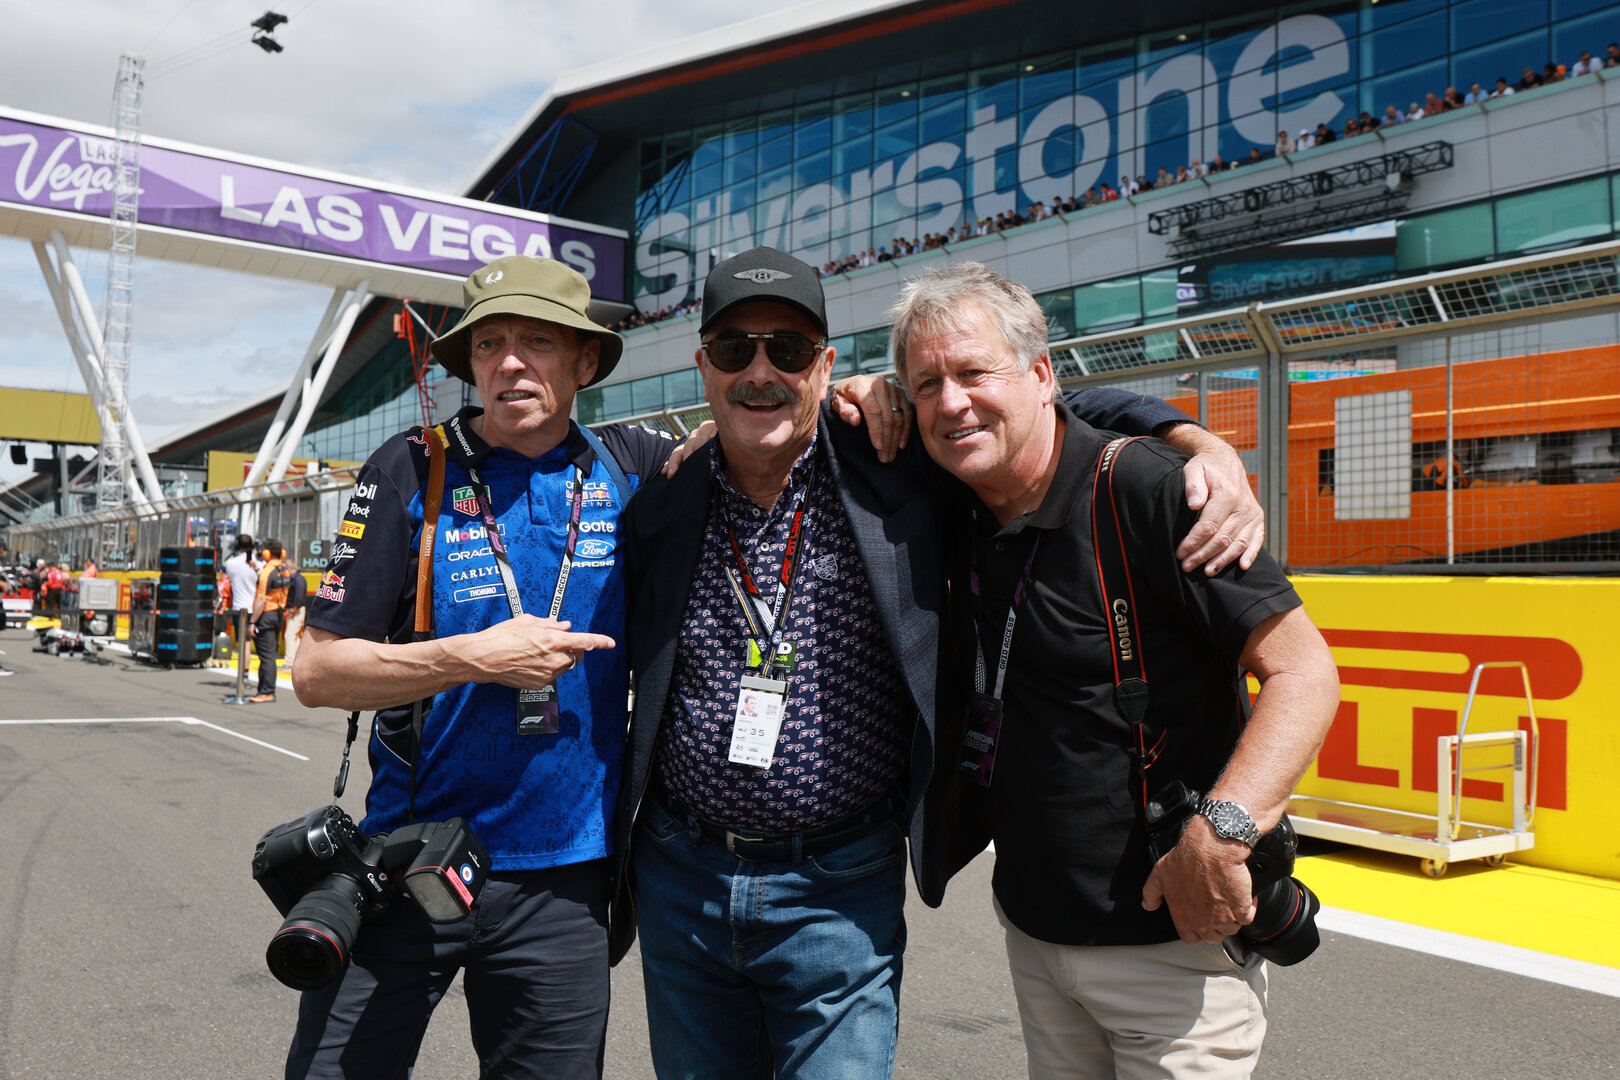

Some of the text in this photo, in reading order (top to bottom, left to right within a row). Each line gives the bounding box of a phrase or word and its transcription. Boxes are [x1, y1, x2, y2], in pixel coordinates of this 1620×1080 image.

[634, 14, 1350, 314] Silverstone
[220, 175, 597, 282] LAS VEGAS
[456, 487, 477, 499] TA
[349, 502, 370, 518] Rock
[456, 498, 480, 516] HEU
[579, 520, 615, 533] Gate
[309, 540, 323, 555] 6
[425, 525, 435, 557] Canon
[582, 541, 608, 556] Ford
[302, 557, 328, 569] HAD
[451, 565, 500, 582] CARLYL
[325, 587, 345, 603] Bull
[551, 564, 570, 617] GRID ACCESS
[1113, 598, 1134, 661] Canon
[1000, 616, 1015, 670] GRID ACCESS
[520, 692, 549, 702] 2026
[967, 730, 995, 747] MEDIA
[366, 872, 383, 893] Canon
